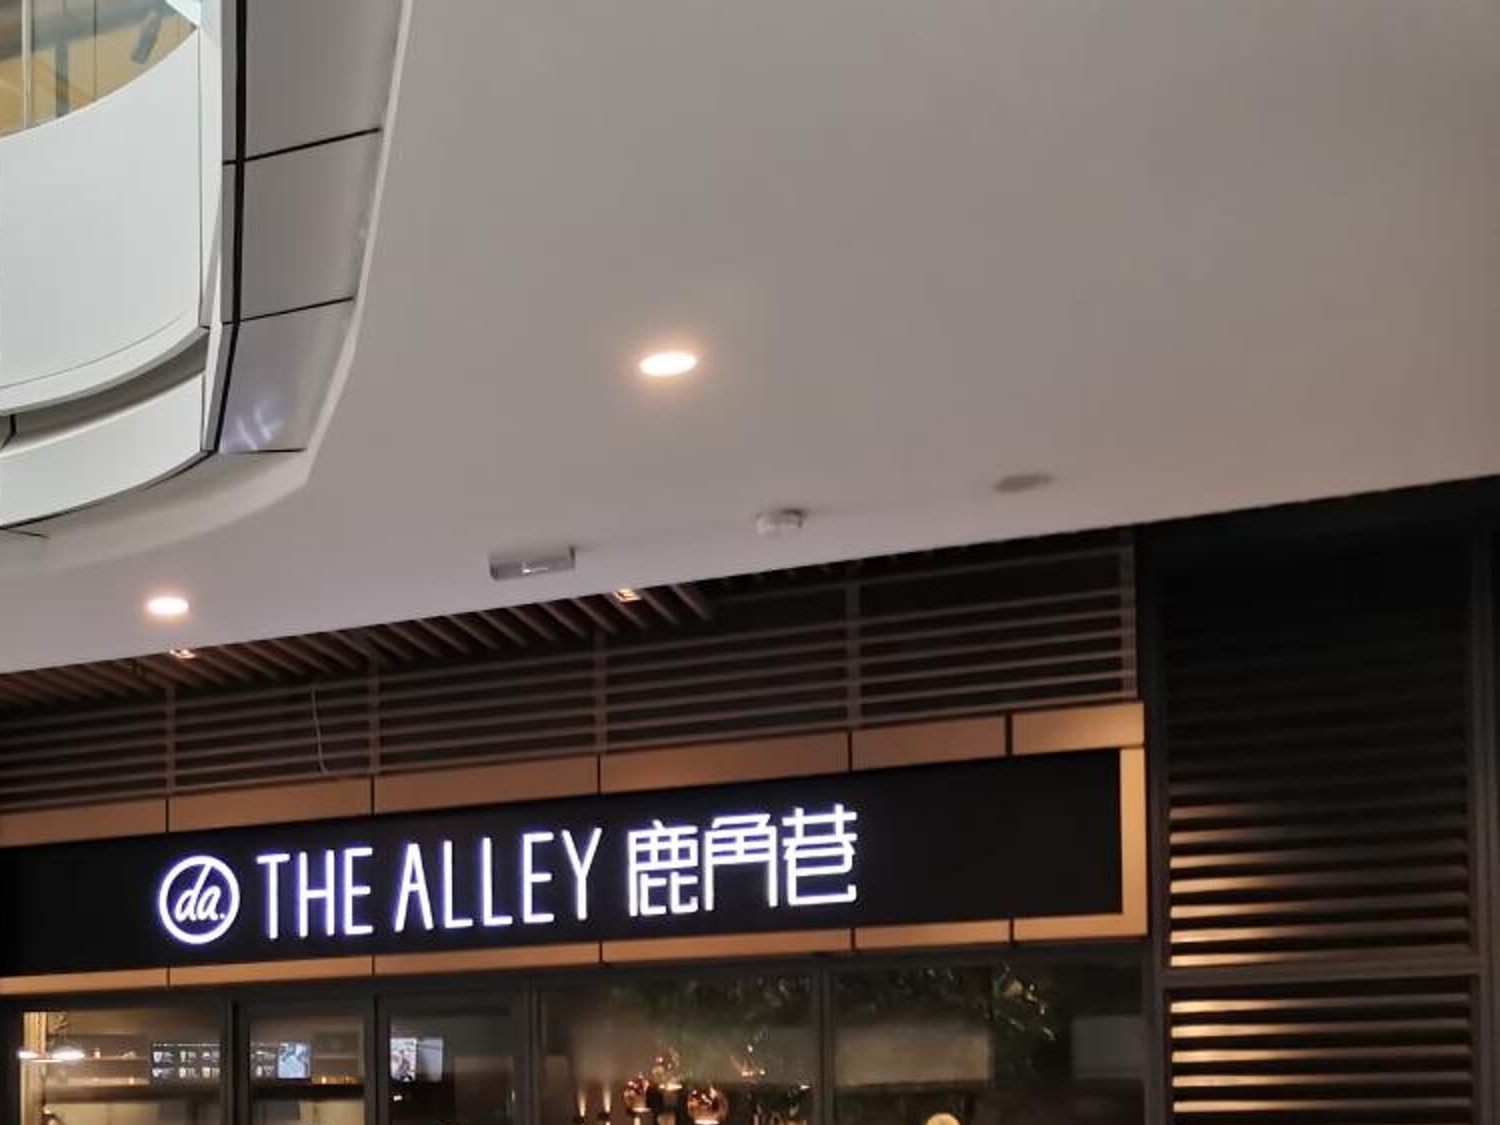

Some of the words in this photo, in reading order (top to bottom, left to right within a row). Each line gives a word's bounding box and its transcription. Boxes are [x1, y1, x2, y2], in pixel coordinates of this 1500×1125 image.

[256, 846, 373, 940] THE
[395, 827, 602, 933] ALLEY
[627, 804, 858, 917] 鹿角巷
